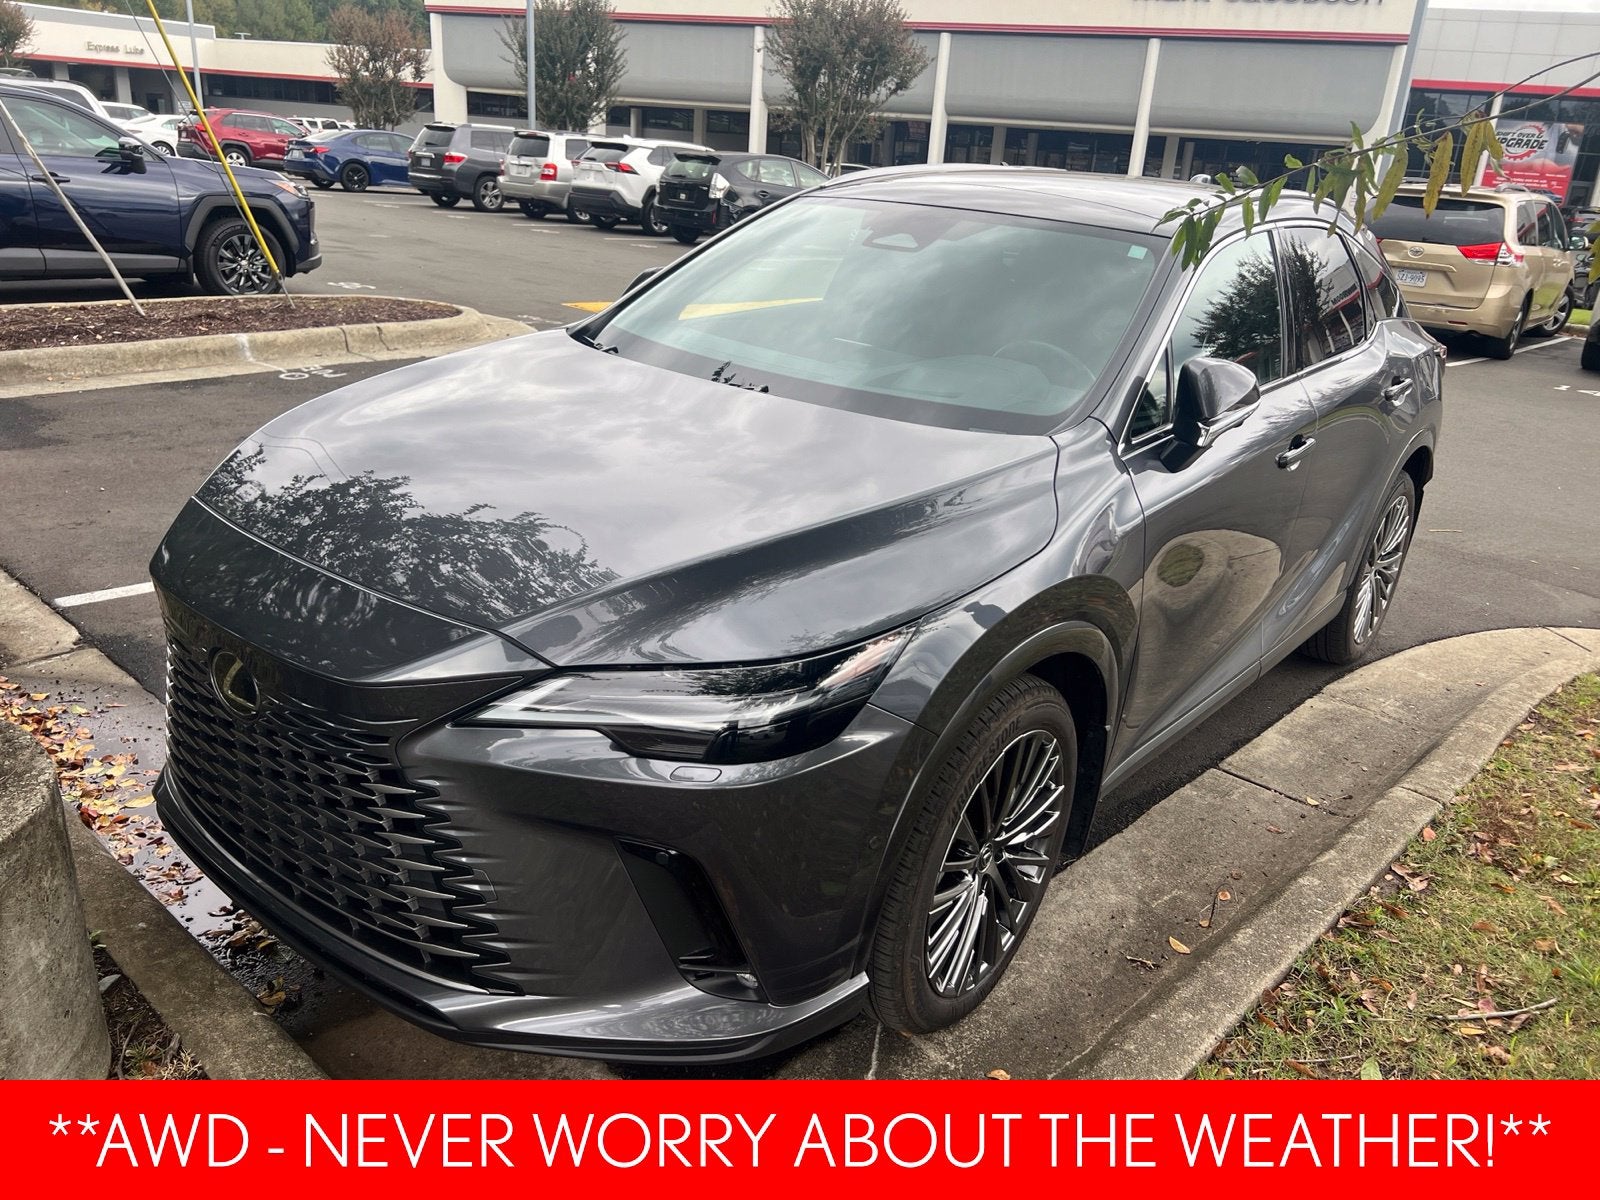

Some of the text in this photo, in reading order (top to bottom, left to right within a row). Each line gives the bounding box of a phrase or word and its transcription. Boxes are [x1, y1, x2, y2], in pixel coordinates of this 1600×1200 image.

[86, 41, 145, 55] Express Lube
[1497, 137, 1548, 149] PGRADE
